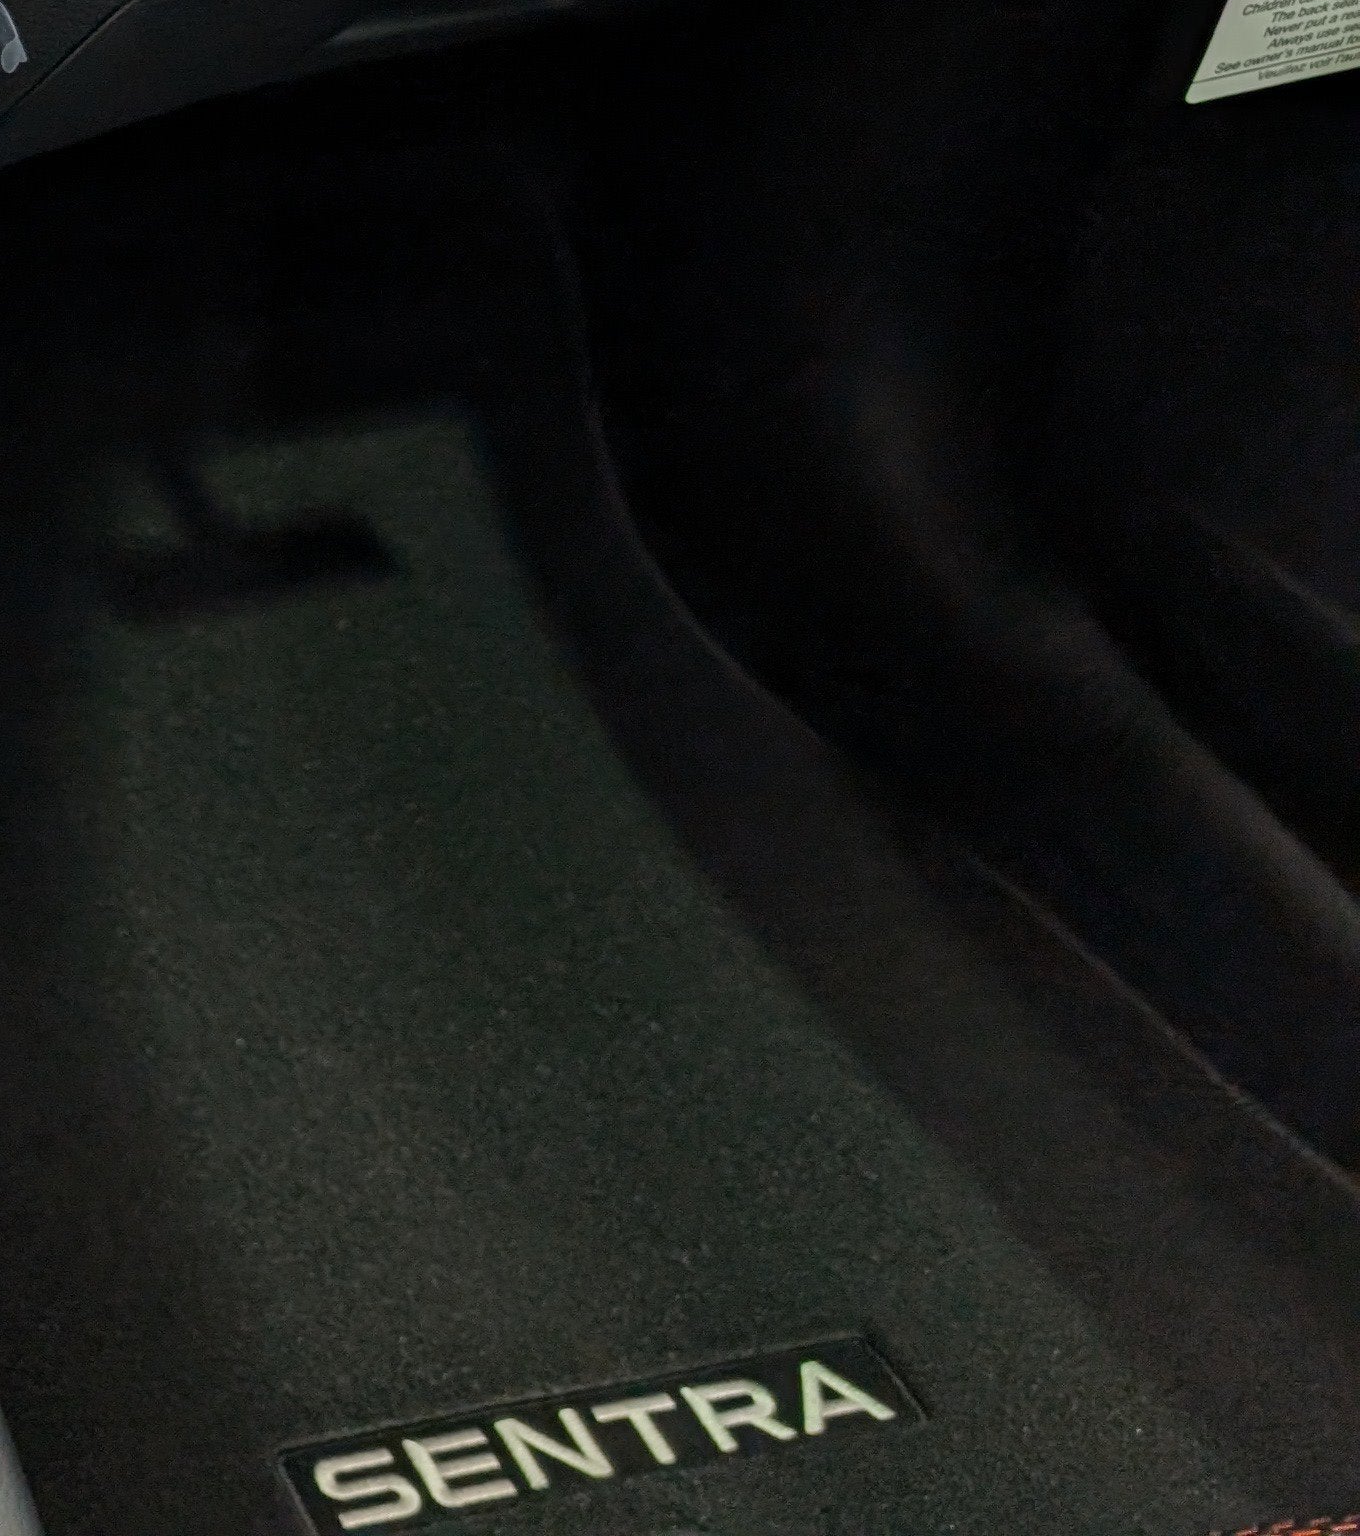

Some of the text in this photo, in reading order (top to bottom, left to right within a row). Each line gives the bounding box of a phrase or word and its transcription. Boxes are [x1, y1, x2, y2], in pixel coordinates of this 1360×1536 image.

[1272, 11, 1295, 23] The
[1298, 2, 1329, 17] back
[1264, 22, 1304, 38] Never
[1304, 15, 1328, 31] put
[1328, 14, 1338, 24] a
[1267, 32, 1314, 49] Always
[1316, 27, 1340, 39] use
[1214, 61, 1241, 74] See
[1243, 48, 1294, 68] owner's
[1296, 37, 1345, 55] manual
[313, 1360, 897, 1531] SENTRA
